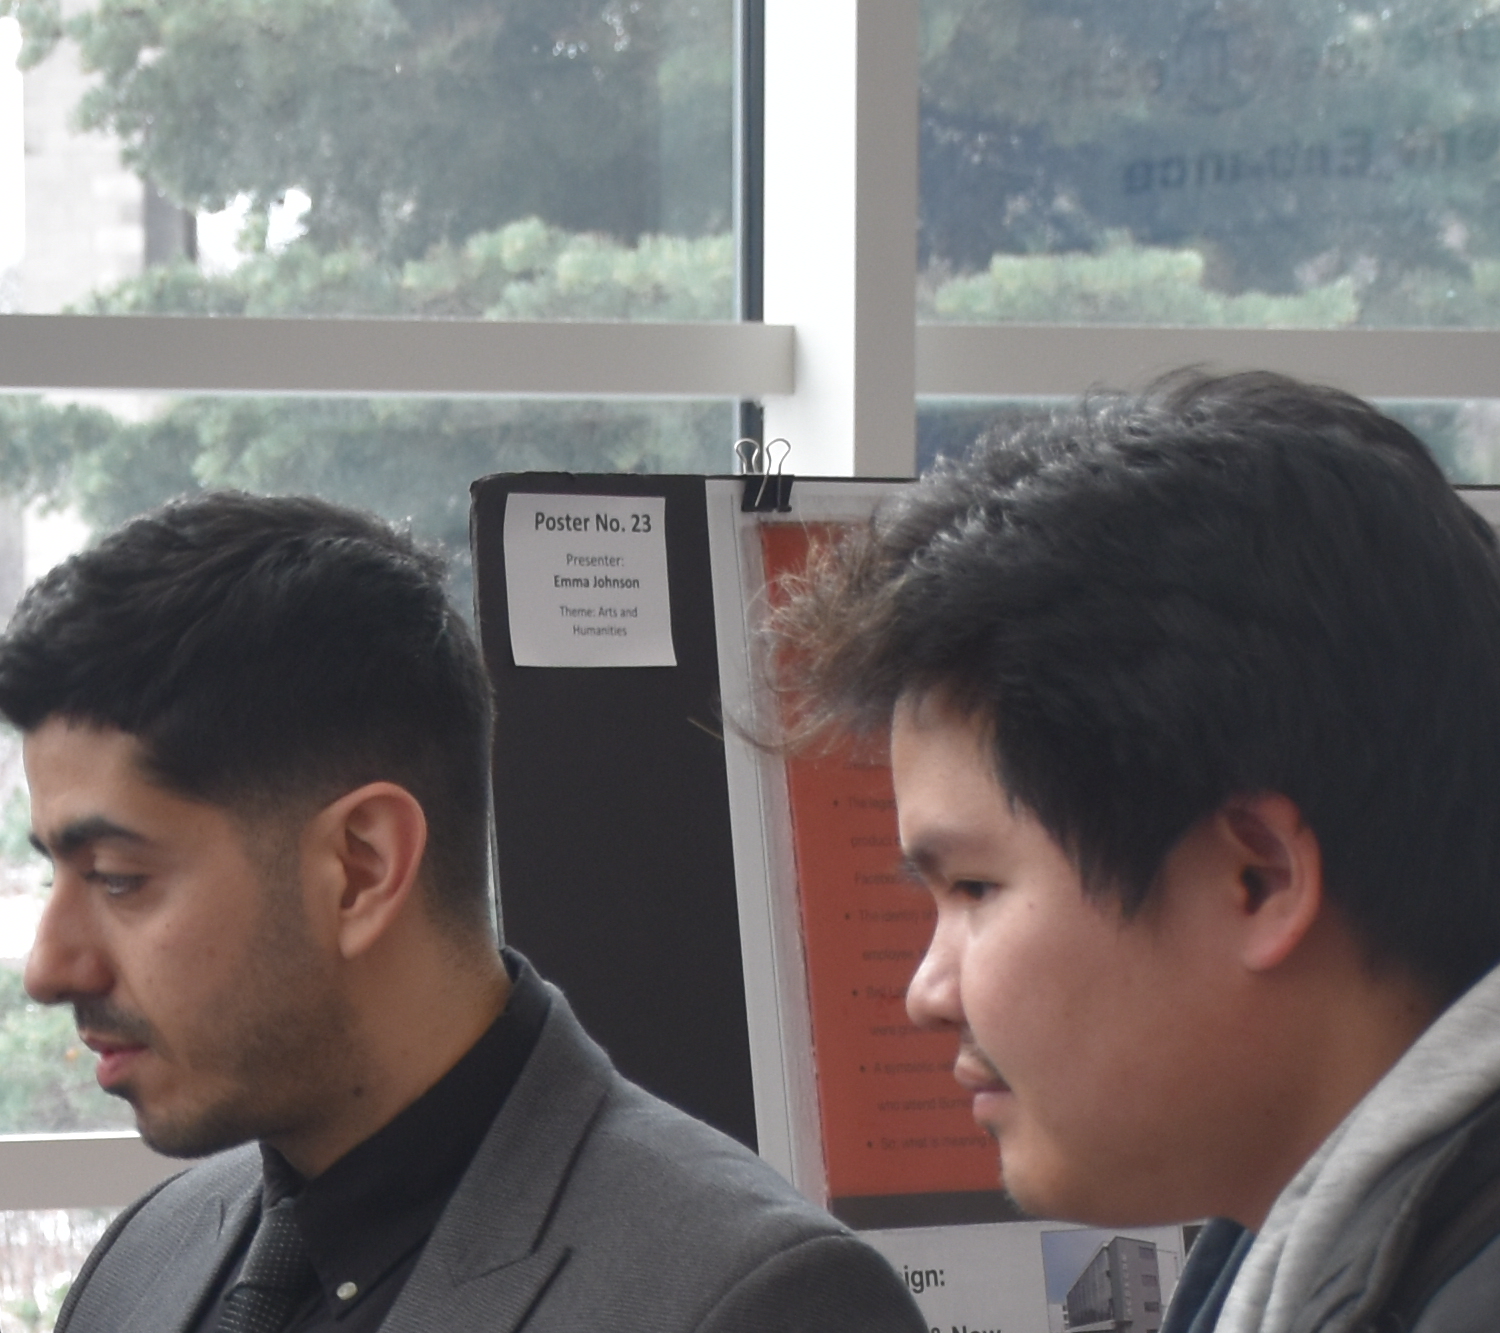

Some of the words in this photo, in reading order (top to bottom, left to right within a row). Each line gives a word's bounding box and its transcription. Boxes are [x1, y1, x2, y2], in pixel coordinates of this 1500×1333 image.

[535, 512, 590, 531] Poster
[596, 513, 625, 532] No.
[631, 514, 651, 533] 23
[566, 553, 623, 567] Presenter:
[554, 575, 589, 588] Emma
[593, 575, 639, 588] Johnson
[560, 605, 595, 617] Theme:
[598, 606, 617, 618] Arts
[620, 607, 638, 618] and
[573, 624, 627, 636] Humanities
[903, 1264, 946, 1294] ign:
